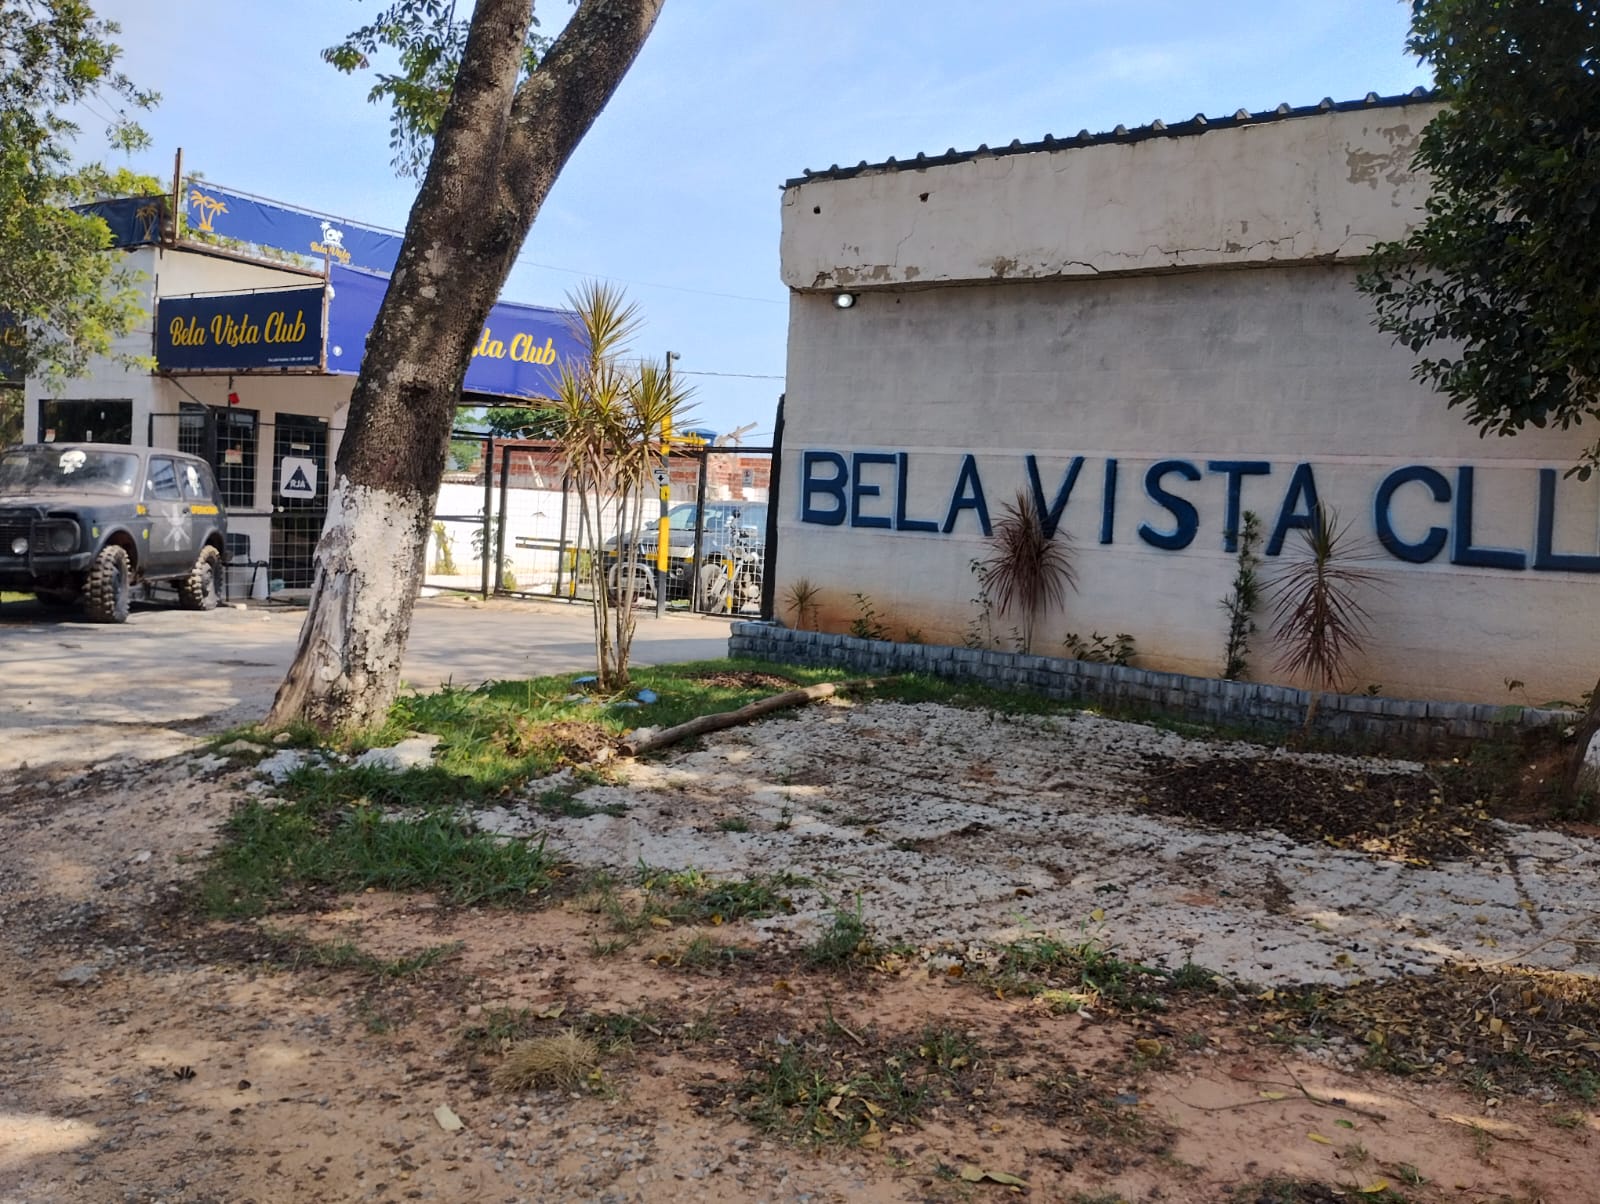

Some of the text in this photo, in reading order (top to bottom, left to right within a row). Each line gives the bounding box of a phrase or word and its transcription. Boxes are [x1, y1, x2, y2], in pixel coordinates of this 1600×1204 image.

[169, 310, 307, 348] Bela Vista Club
[509, 333, 556, 366] Club
[801, 449, 995, 537] BELA
[1024, 453, 1332, 557] VISTA
